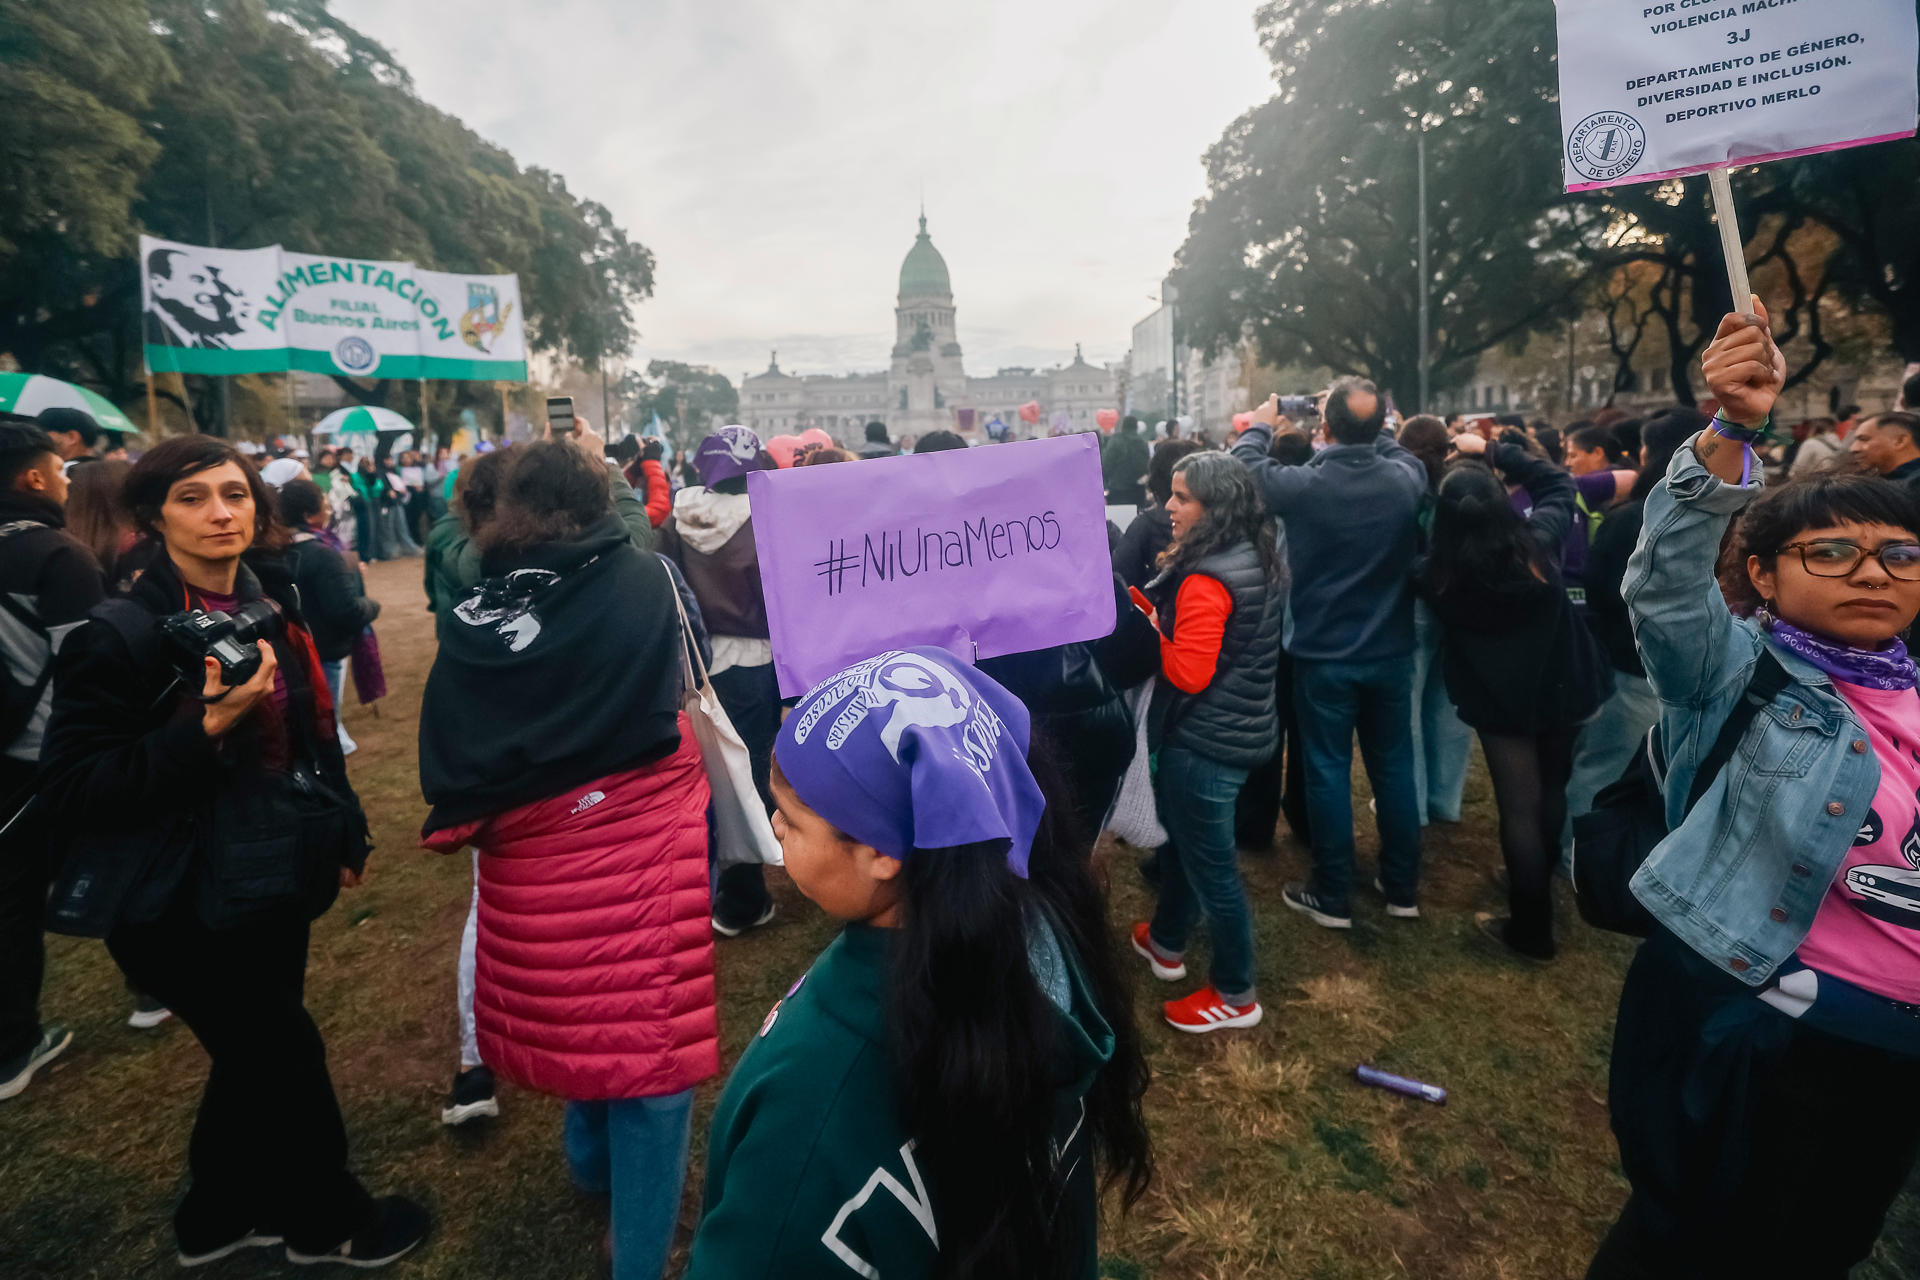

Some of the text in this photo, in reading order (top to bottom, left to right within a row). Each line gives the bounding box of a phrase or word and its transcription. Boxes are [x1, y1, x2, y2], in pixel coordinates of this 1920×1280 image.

[1643, 3, 1675, 18] POR
[1651, 7, 1738, 35] VIOLENCIA
[1726, 28, 1751, 45] 3J
[1626, 32, 1865, 90] DEPARTAMENTO DE GÉNERO,
[1637, 55, 1852, 107] DIVERSIDAD E INCLUSIÓN.
[1665, 85, 1821, 123] DEPORTIVO MERLO
[1573, 115, 1636, 163] DEPARTAMENTO
[1588, 167, 1603, 177] DE
[1607, 140, 1642, 176] GÉNERO
[293, 308, 420, 331] Buenos Aires
[814, 510, 1061, 596] #NiUnaMenos
